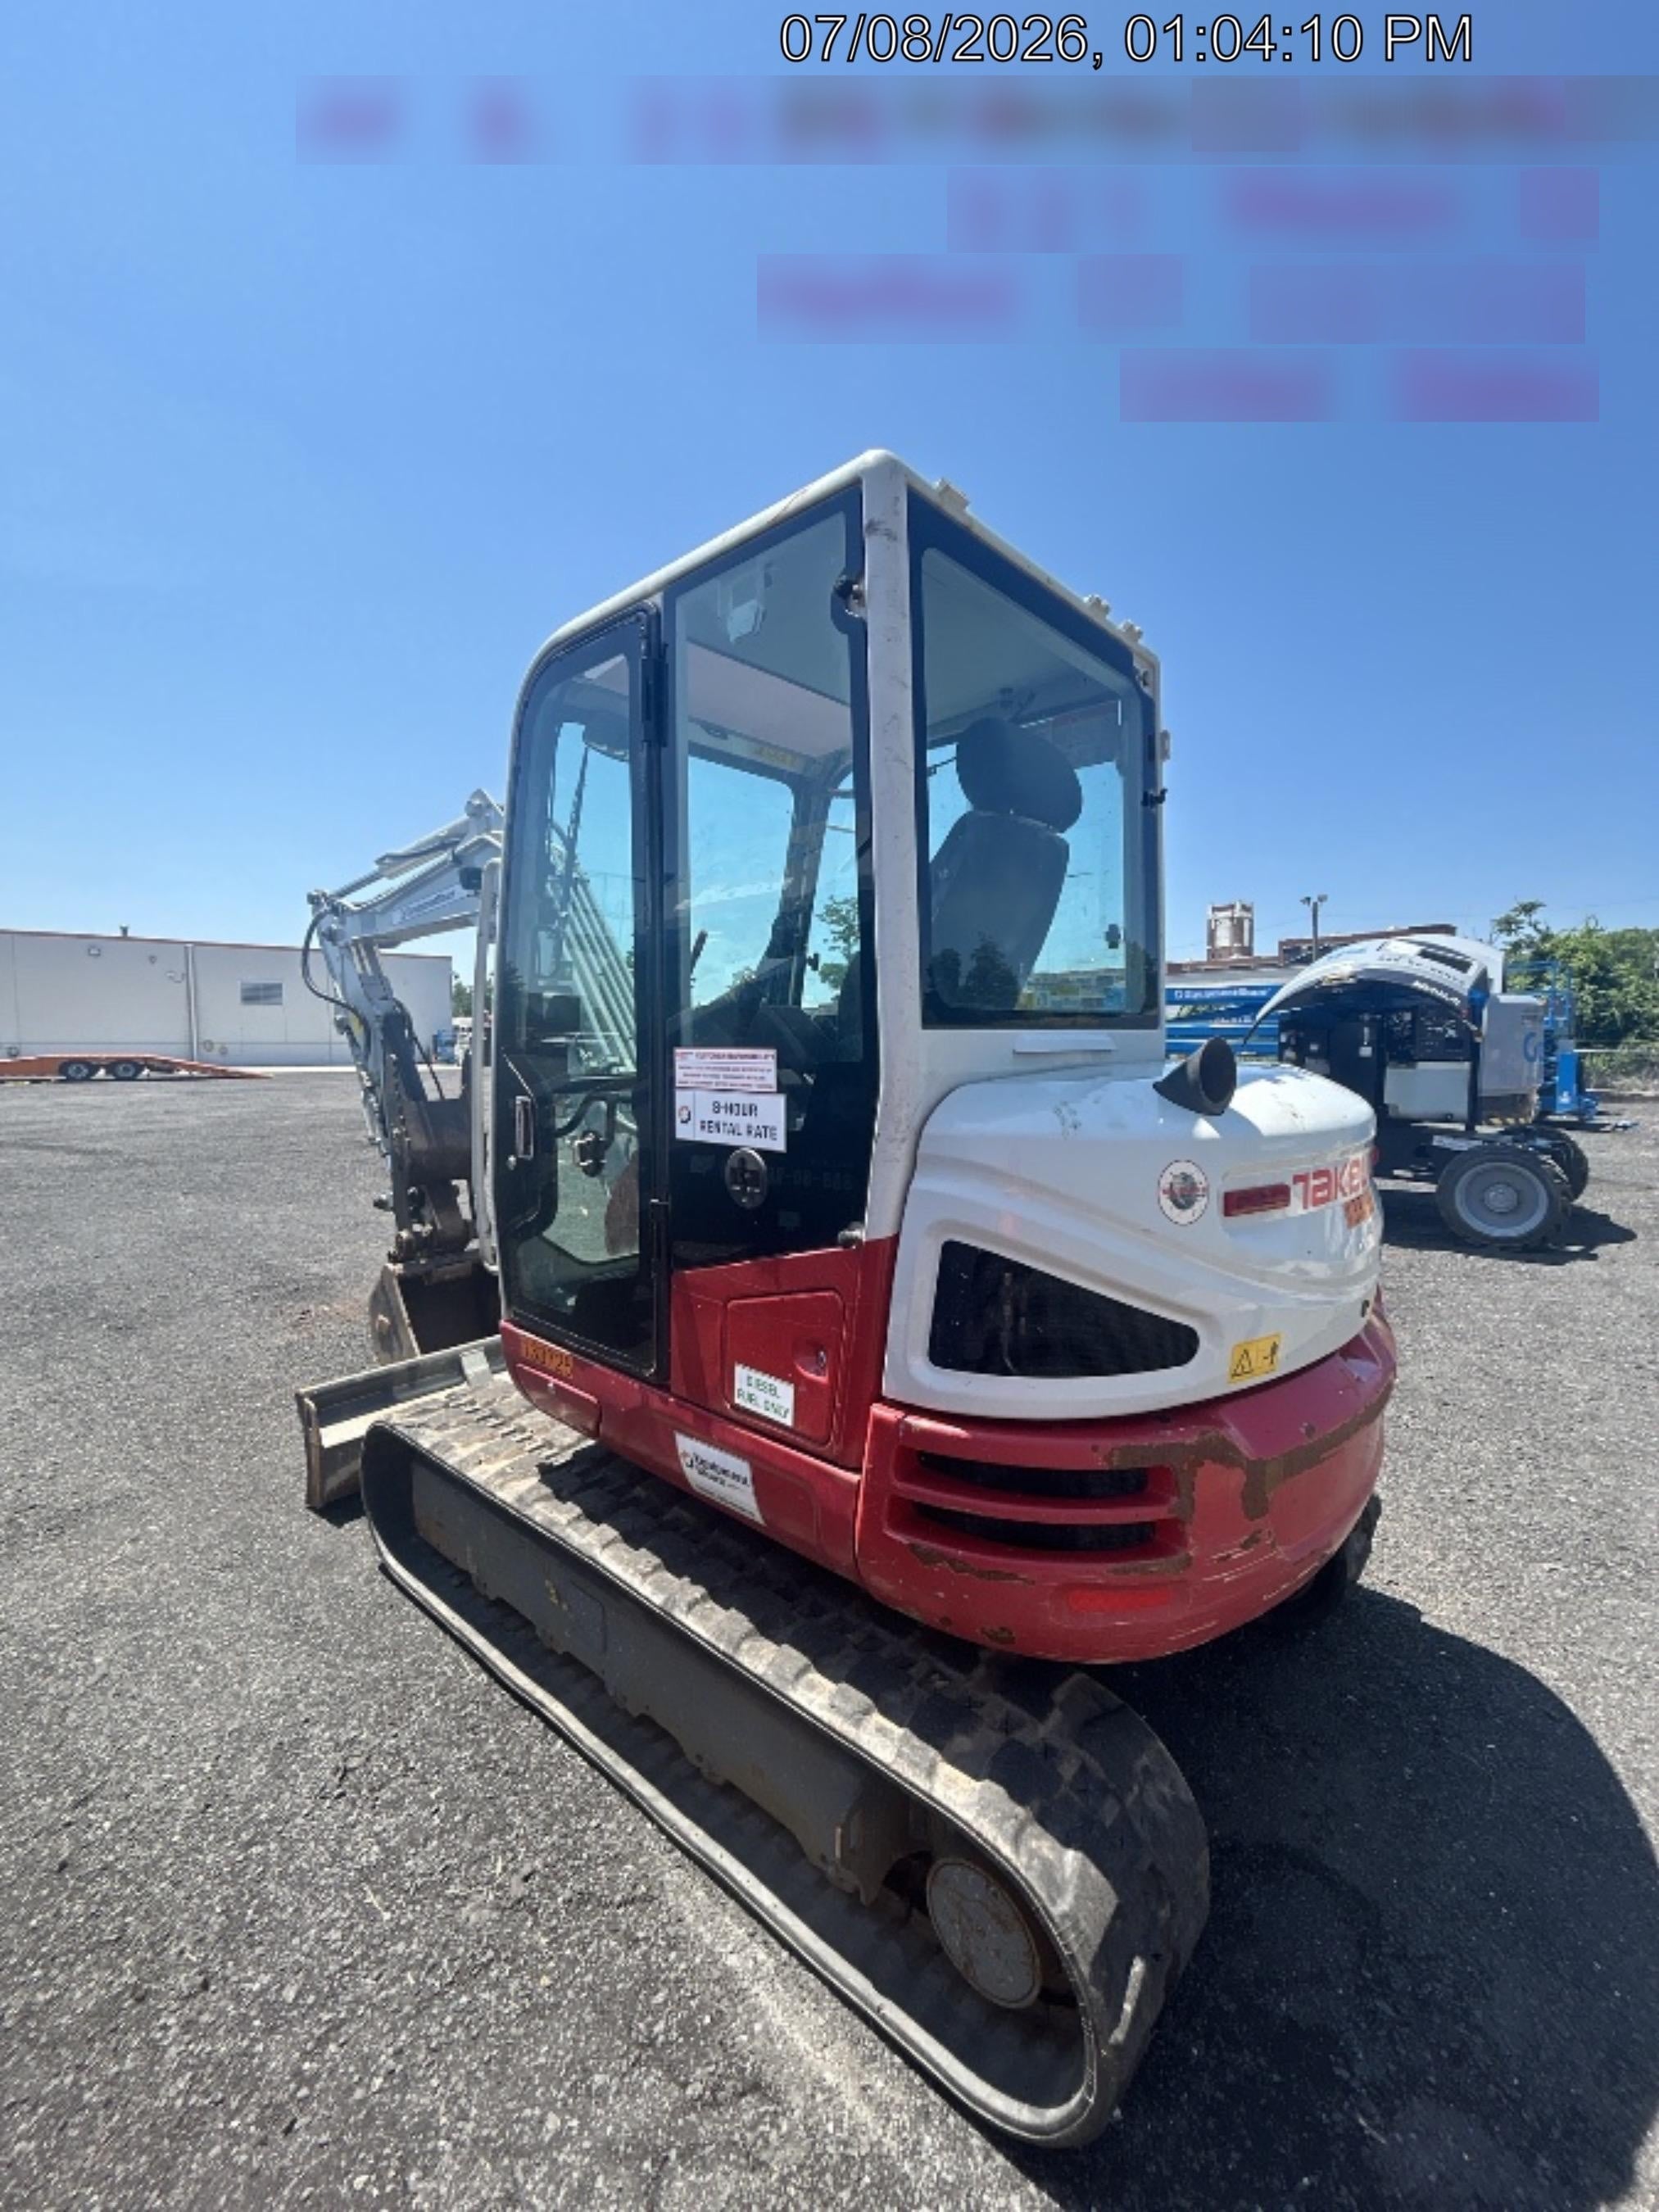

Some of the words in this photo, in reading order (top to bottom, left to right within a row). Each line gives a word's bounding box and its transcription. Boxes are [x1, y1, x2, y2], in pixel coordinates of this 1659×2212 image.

[712, 1100, 759, 1117] 8-HOUR
[700, 1119, 743, 1136] RENTAL
[746, 1124, 778, 1141] RATE
